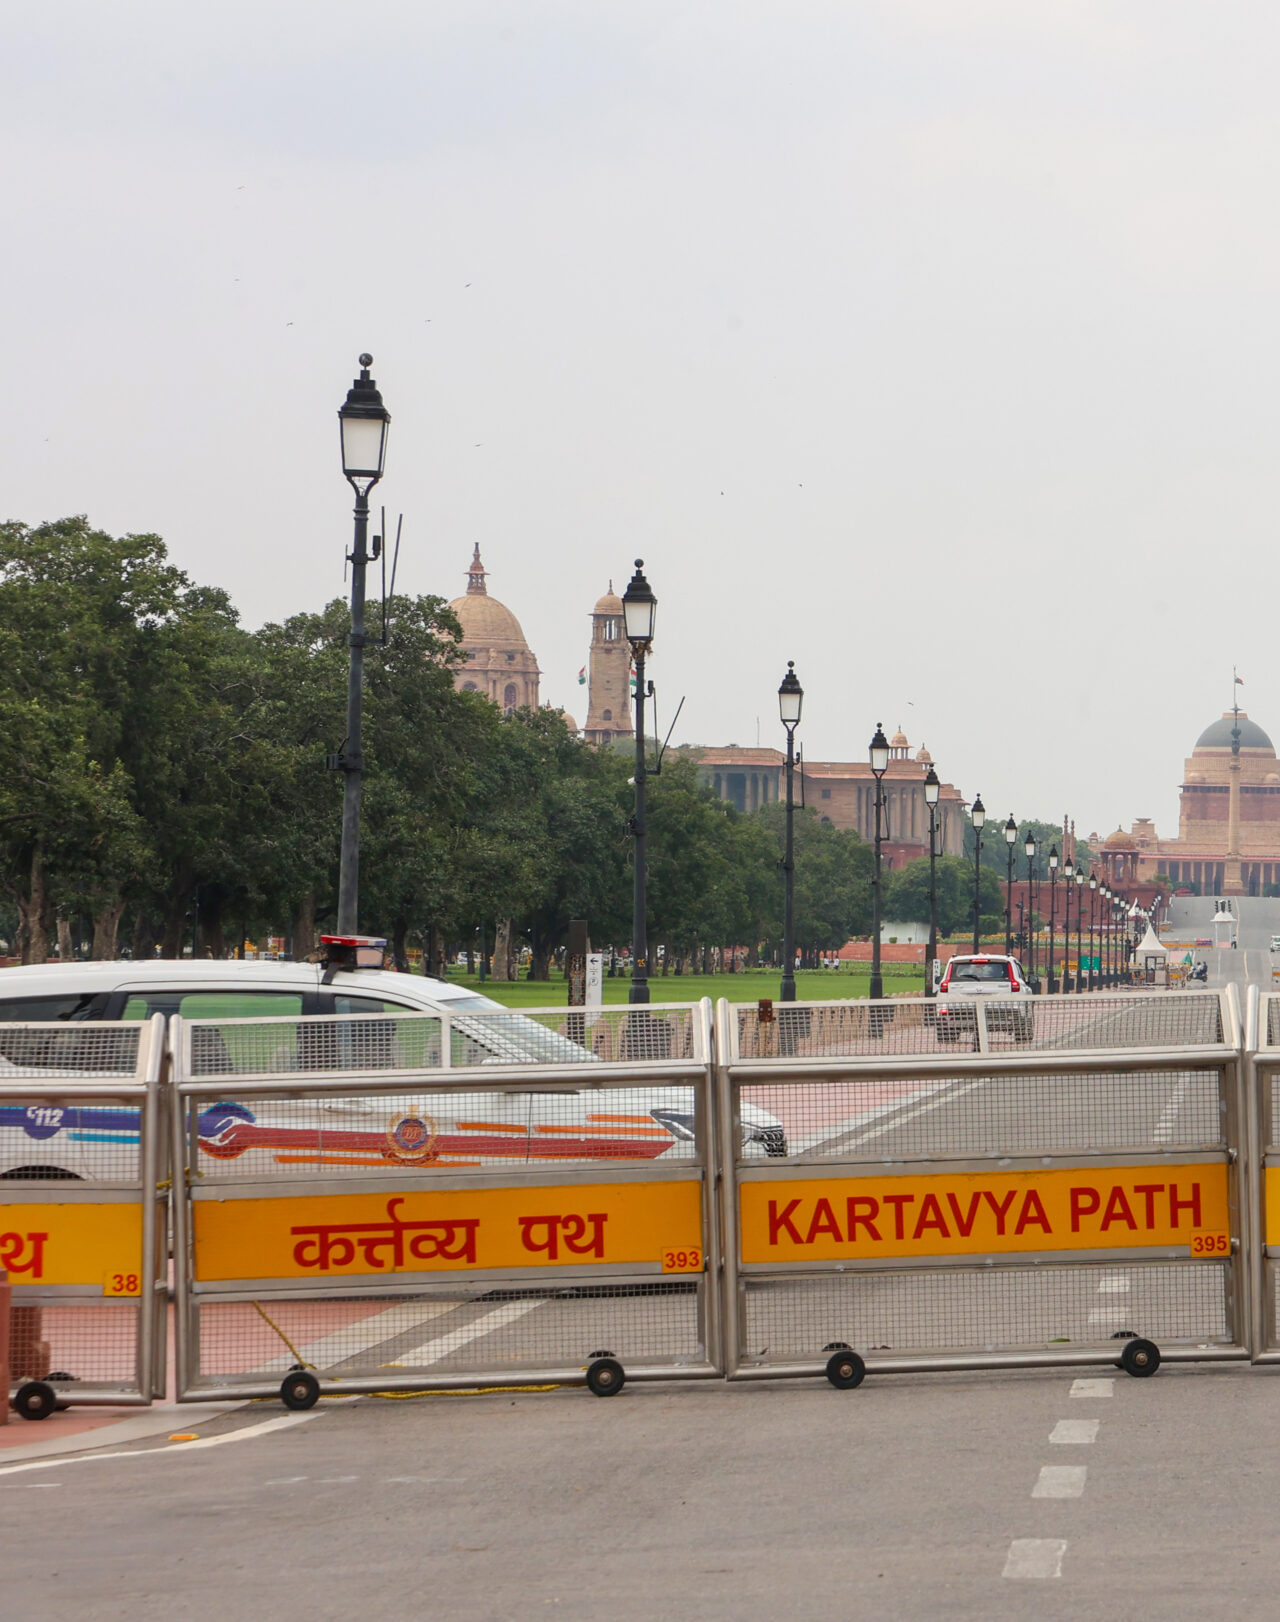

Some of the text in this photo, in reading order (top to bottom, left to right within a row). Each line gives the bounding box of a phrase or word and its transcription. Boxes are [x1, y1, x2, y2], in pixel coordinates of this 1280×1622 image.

[35, 1107, 64, 1127] 112
[768, 1183, 1202, 1245] KARTAVYA PATH
[518, 1213, 608, 1260] पथ
[1193, 1234, 1229, 1252] 395
[0, 1232, 48, 1278] थ
[665, 1250, 700, 1268] 393
[112, 1274, 139, 1292] 38
